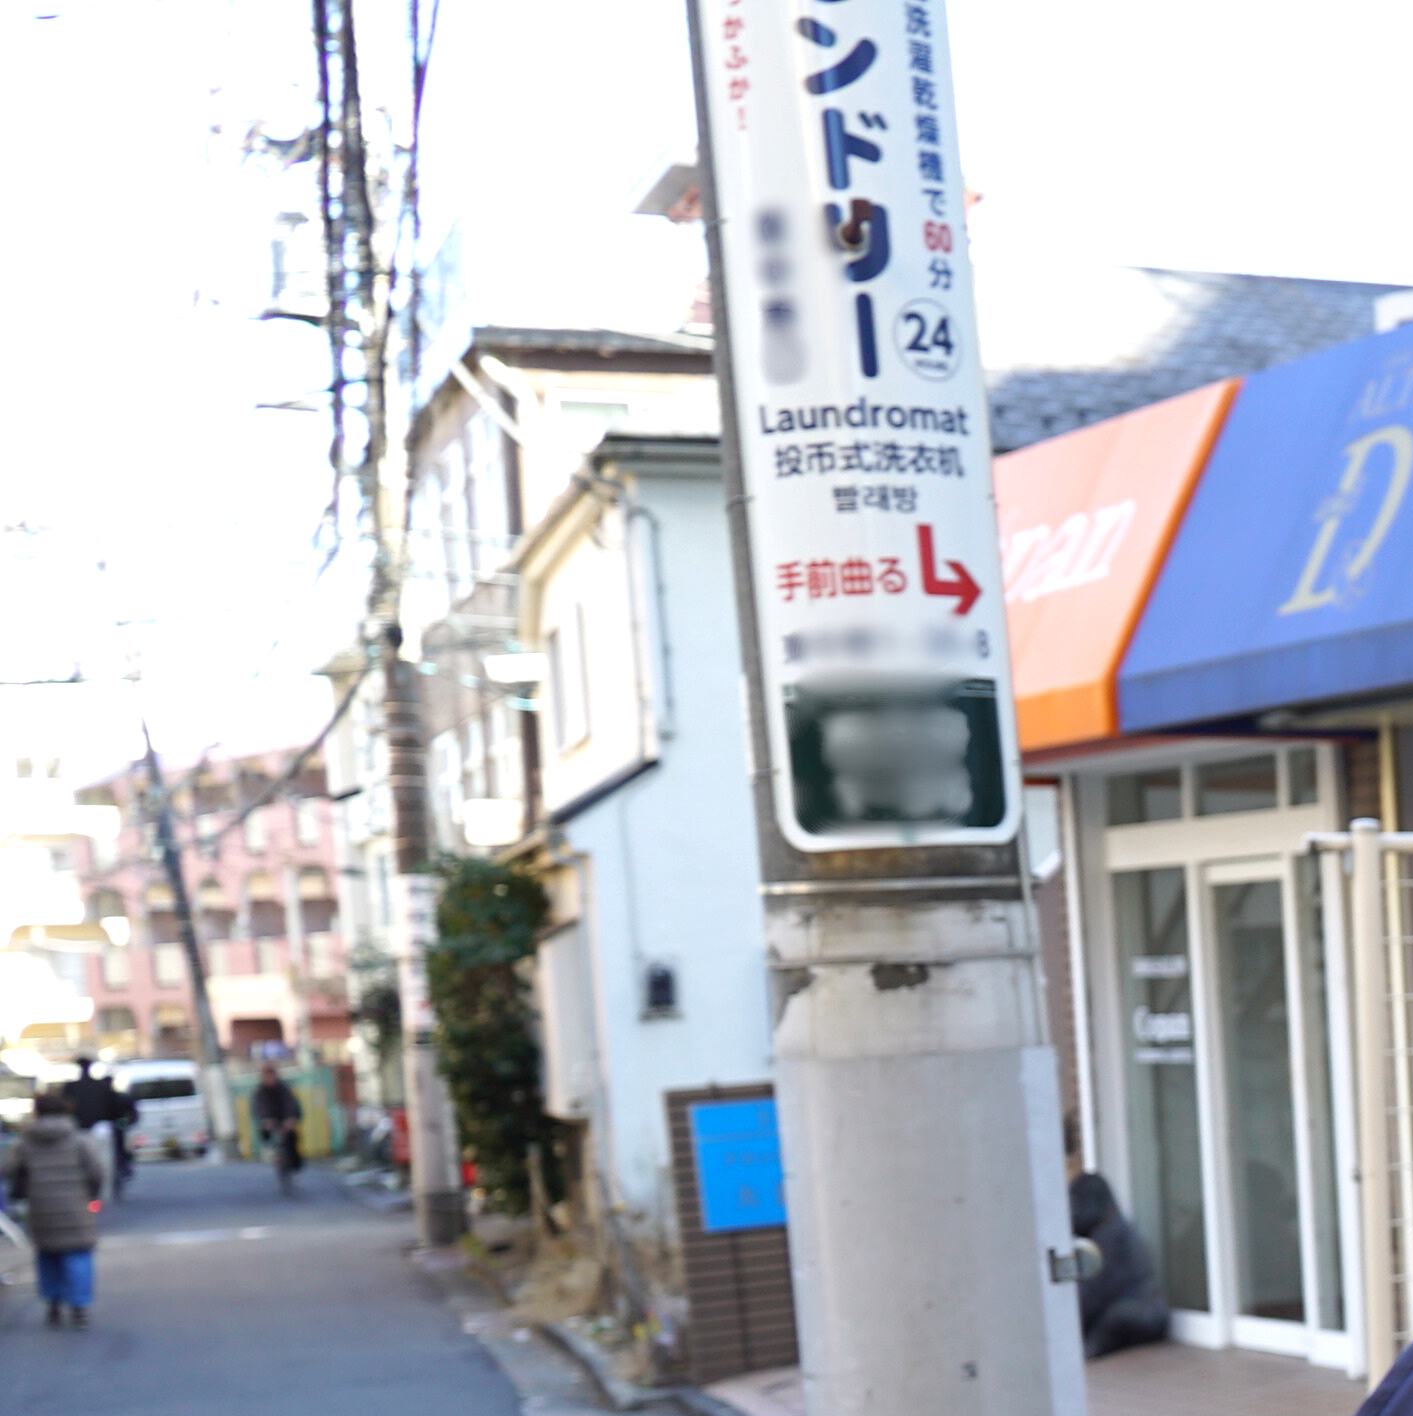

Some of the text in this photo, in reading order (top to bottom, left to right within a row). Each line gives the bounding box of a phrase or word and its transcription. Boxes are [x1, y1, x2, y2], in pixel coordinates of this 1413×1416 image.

[796, 0, 892, 379] ンドリー
[902, 311, 955, 356] 24
[759, 398, 971, 436] Laundromat
[776, 557, 909, 602] 手前曲る
